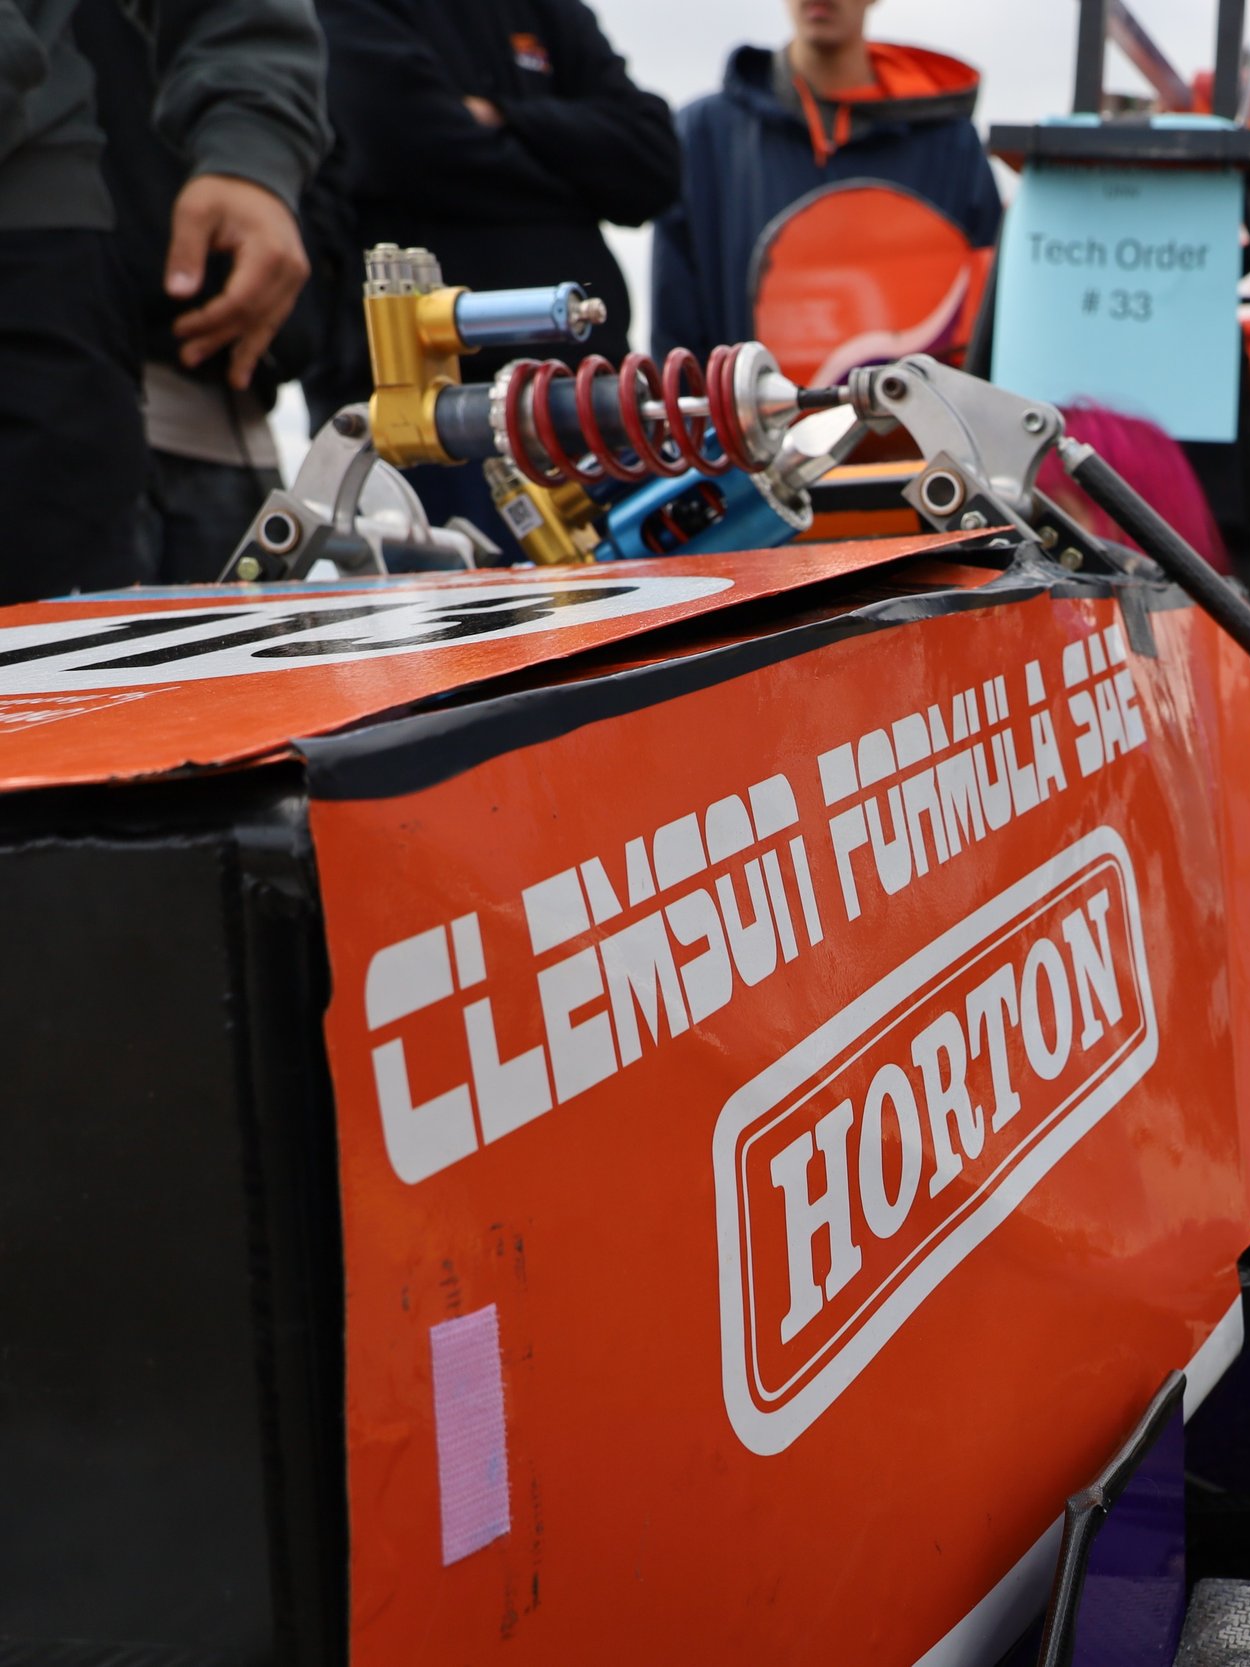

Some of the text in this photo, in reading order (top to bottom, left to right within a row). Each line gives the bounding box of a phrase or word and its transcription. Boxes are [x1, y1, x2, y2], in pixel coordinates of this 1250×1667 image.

[1029, 231, 1210, 273] Tech Order
[1081, 287, 1153, 323] # 33
[364, 623, 1148, 1186] CLEMSON FORMULA SAE
[769, 887, 1126, 1346] HORTON
